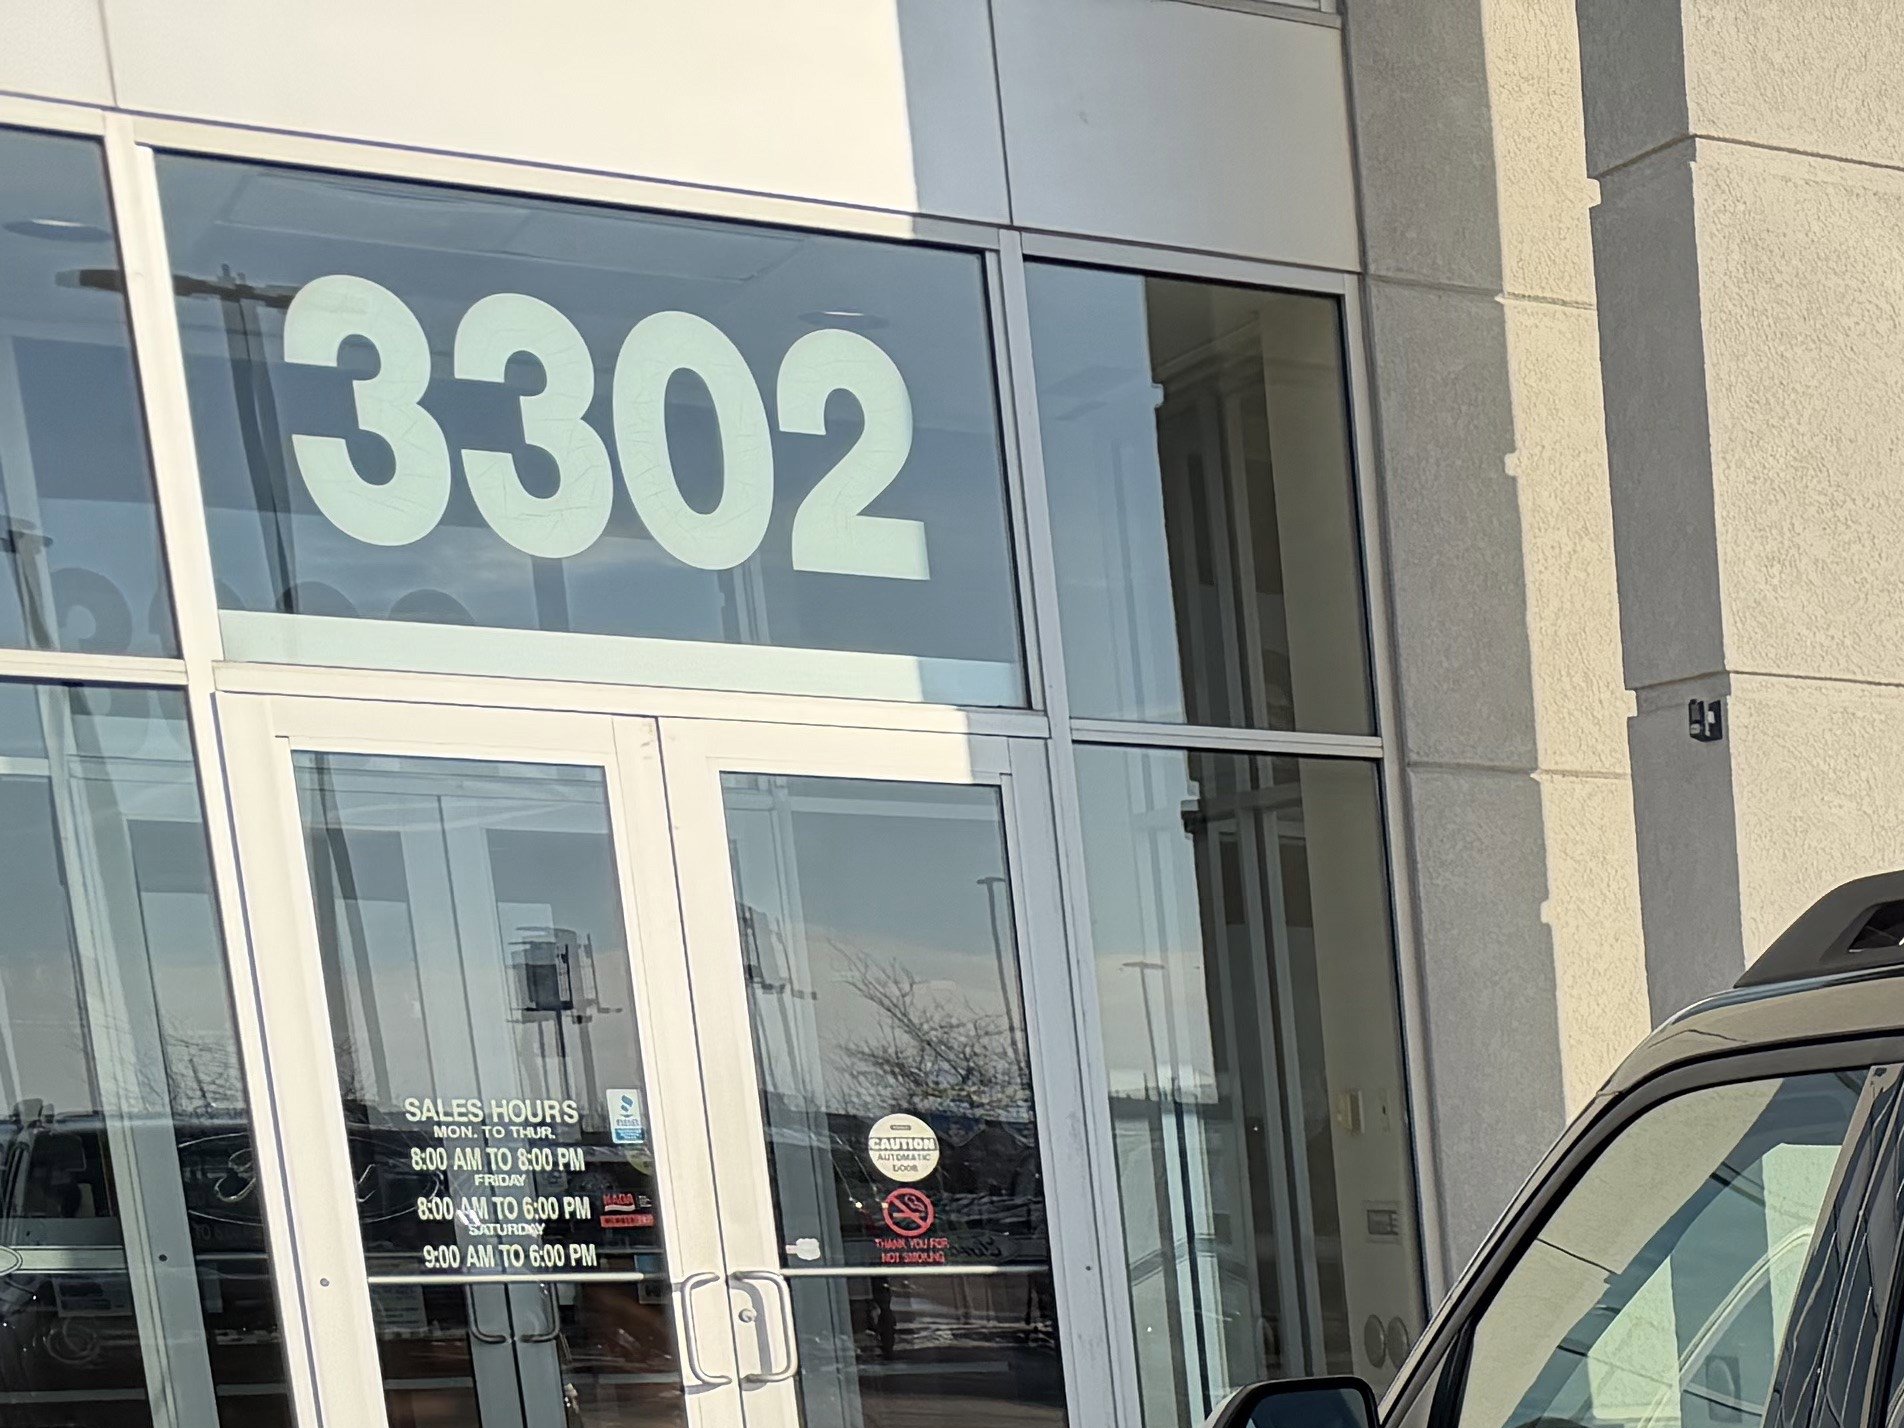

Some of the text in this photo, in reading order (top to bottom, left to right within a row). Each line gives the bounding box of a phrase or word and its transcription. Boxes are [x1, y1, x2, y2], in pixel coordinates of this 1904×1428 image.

[283, 275, 930, 581] 3302
[403, 1097, 580, 1124] SALES HOURS
[433, 1125, 556, 1140] MON. TO THUR.
[870, 1137, 936, 1151] CAUTION
[410, 1147, 586, 1172] 8:00 AM TO 8:00 PM
[474, 1174, 527, 1187] FRIDAY
[417, 1196, 592, 1221] 8:00 AM TO 6:00 PM
[468, 1223, 546, 1237] SATURDAY
[423, 1243, 598, 1269] 9:00 AM TO 6:00 PM
